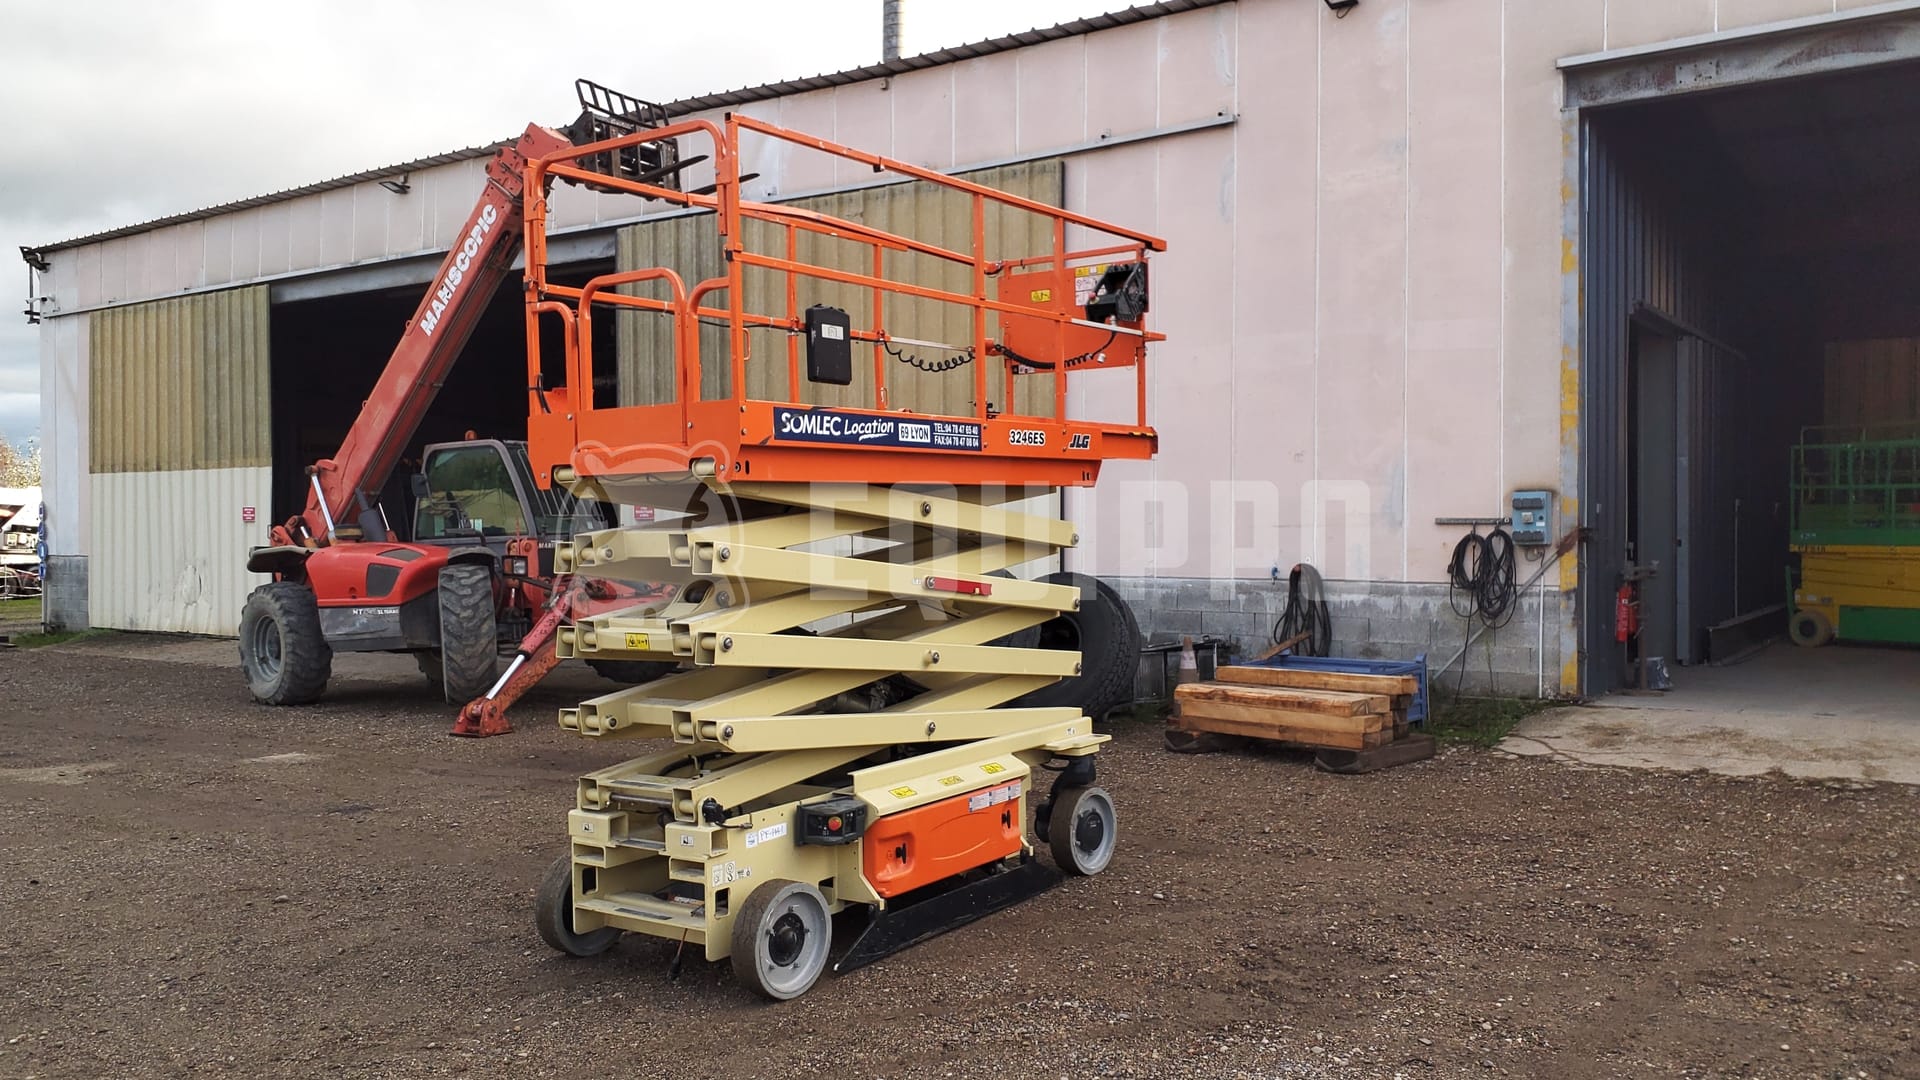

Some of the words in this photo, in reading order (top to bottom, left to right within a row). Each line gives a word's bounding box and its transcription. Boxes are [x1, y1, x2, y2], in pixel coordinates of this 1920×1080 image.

[420, 204, 497, 336] MANISCOPIC
[781, 412, 842, 436] SOMLEC
[844, 419, 894, 435] Location
[900, 425, 909, 439] 69
[910, 426, 929, 440] LYON
[1010, 431, 1045, 445] 3246ES
[1069, 434, 1090, 449] JLG
